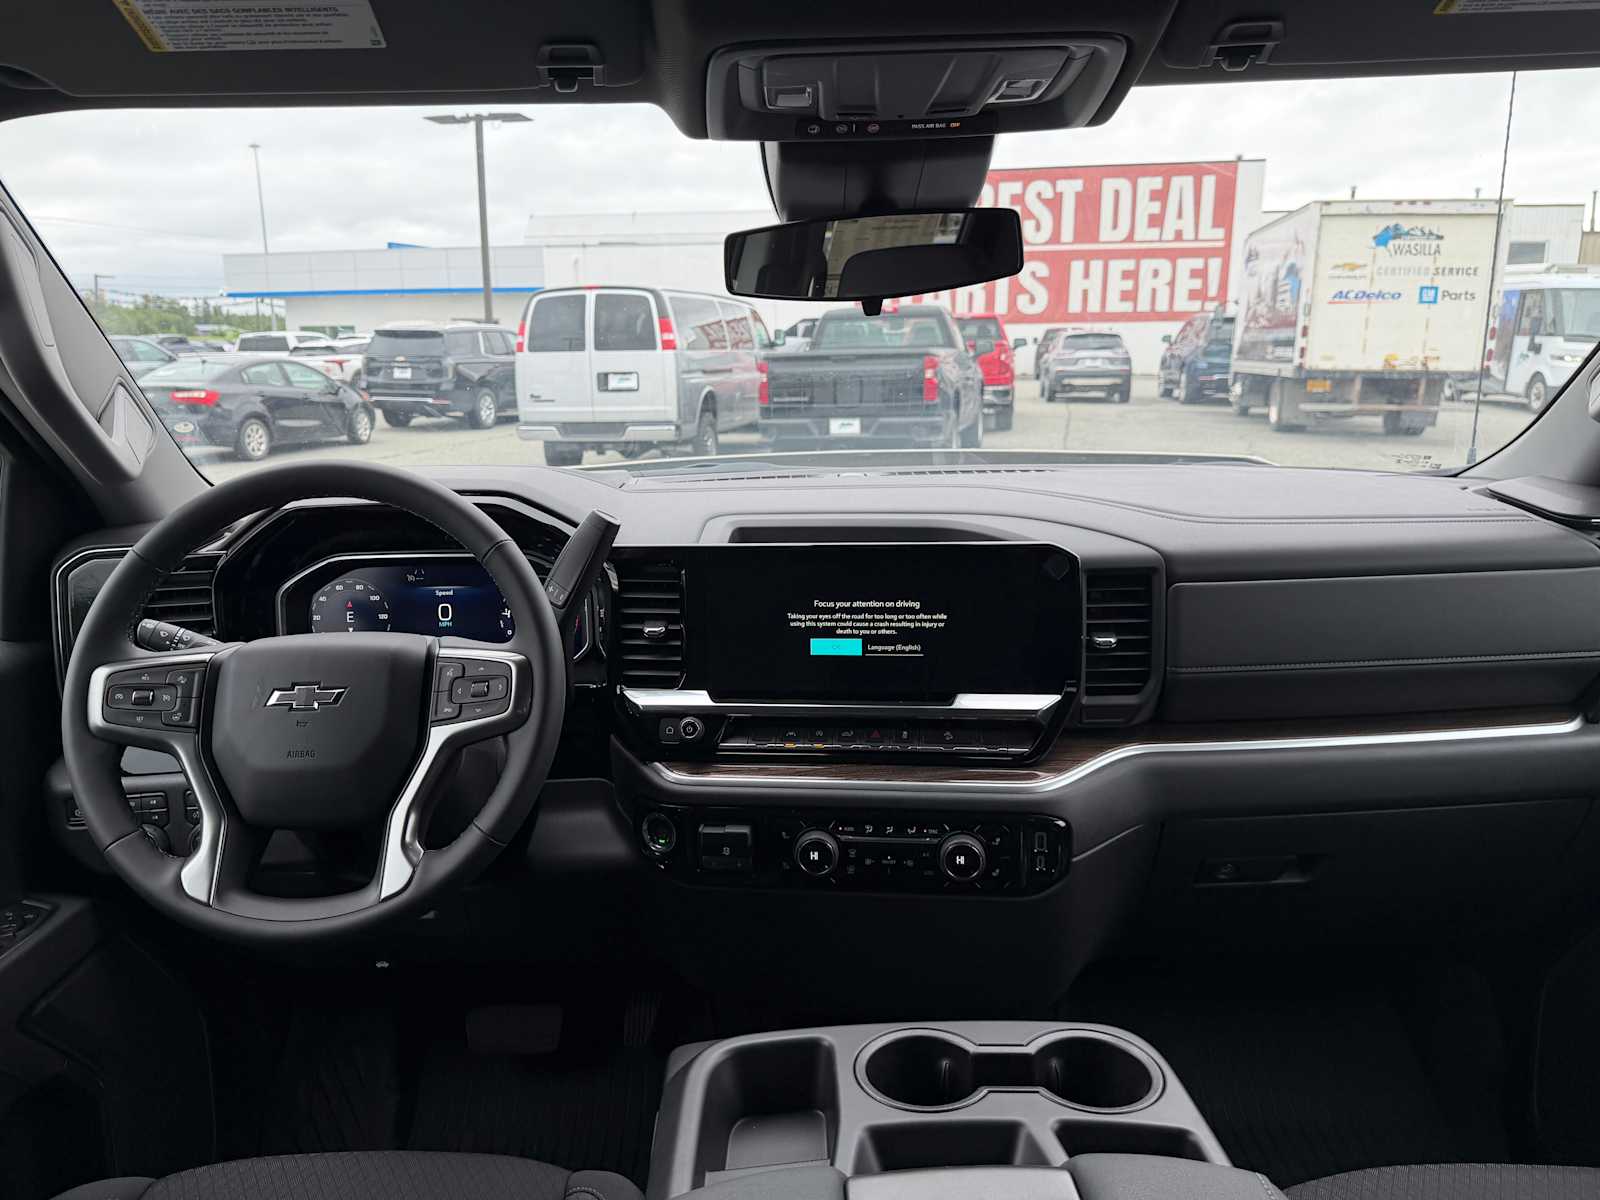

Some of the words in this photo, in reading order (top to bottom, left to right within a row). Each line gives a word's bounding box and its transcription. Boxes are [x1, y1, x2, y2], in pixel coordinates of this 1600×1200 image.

[1098, 174, 1225, 243] DEAL
[1392, 243, 1442, 257] WASILLA
[1432, 266, 1480, 277] SERVICE
[1067, 257, 1223, 314] HERE!
[1332, 289, 1402, 301] ACDelco
[1441, 289, 1477, 301] Parts
[435, 589, 454, 597] Speed
[814, 599, 835, 608] Focus
[835, 601, 851, 610] your
[852, 599, 885, 608] attention
[896, 599, 921, 610] driving
[346, 611, 355, 623] E
[437, 603, 453, 621] 0
[787, 612, 806, 621] Taking
[832, 612, 841, 620] off
[841, 612, 851, 620] the
[851, 612, 865, 620] road
[865, 612, 873, 620] for
[884, 612, 898, 621] long
[915, 612, 932, 620] often
[932, 612, 948, 620] while
[790, 620, 805, 629] using
[890, 620, 914, 628] resulting
[921, 620, 937, 629] injury
[836, 627, 853, 635] death
[867, 643, 896, 652] Language
[895, 643, 922, 652] (English)
[286, 750, 316, 759] AIRBAG
